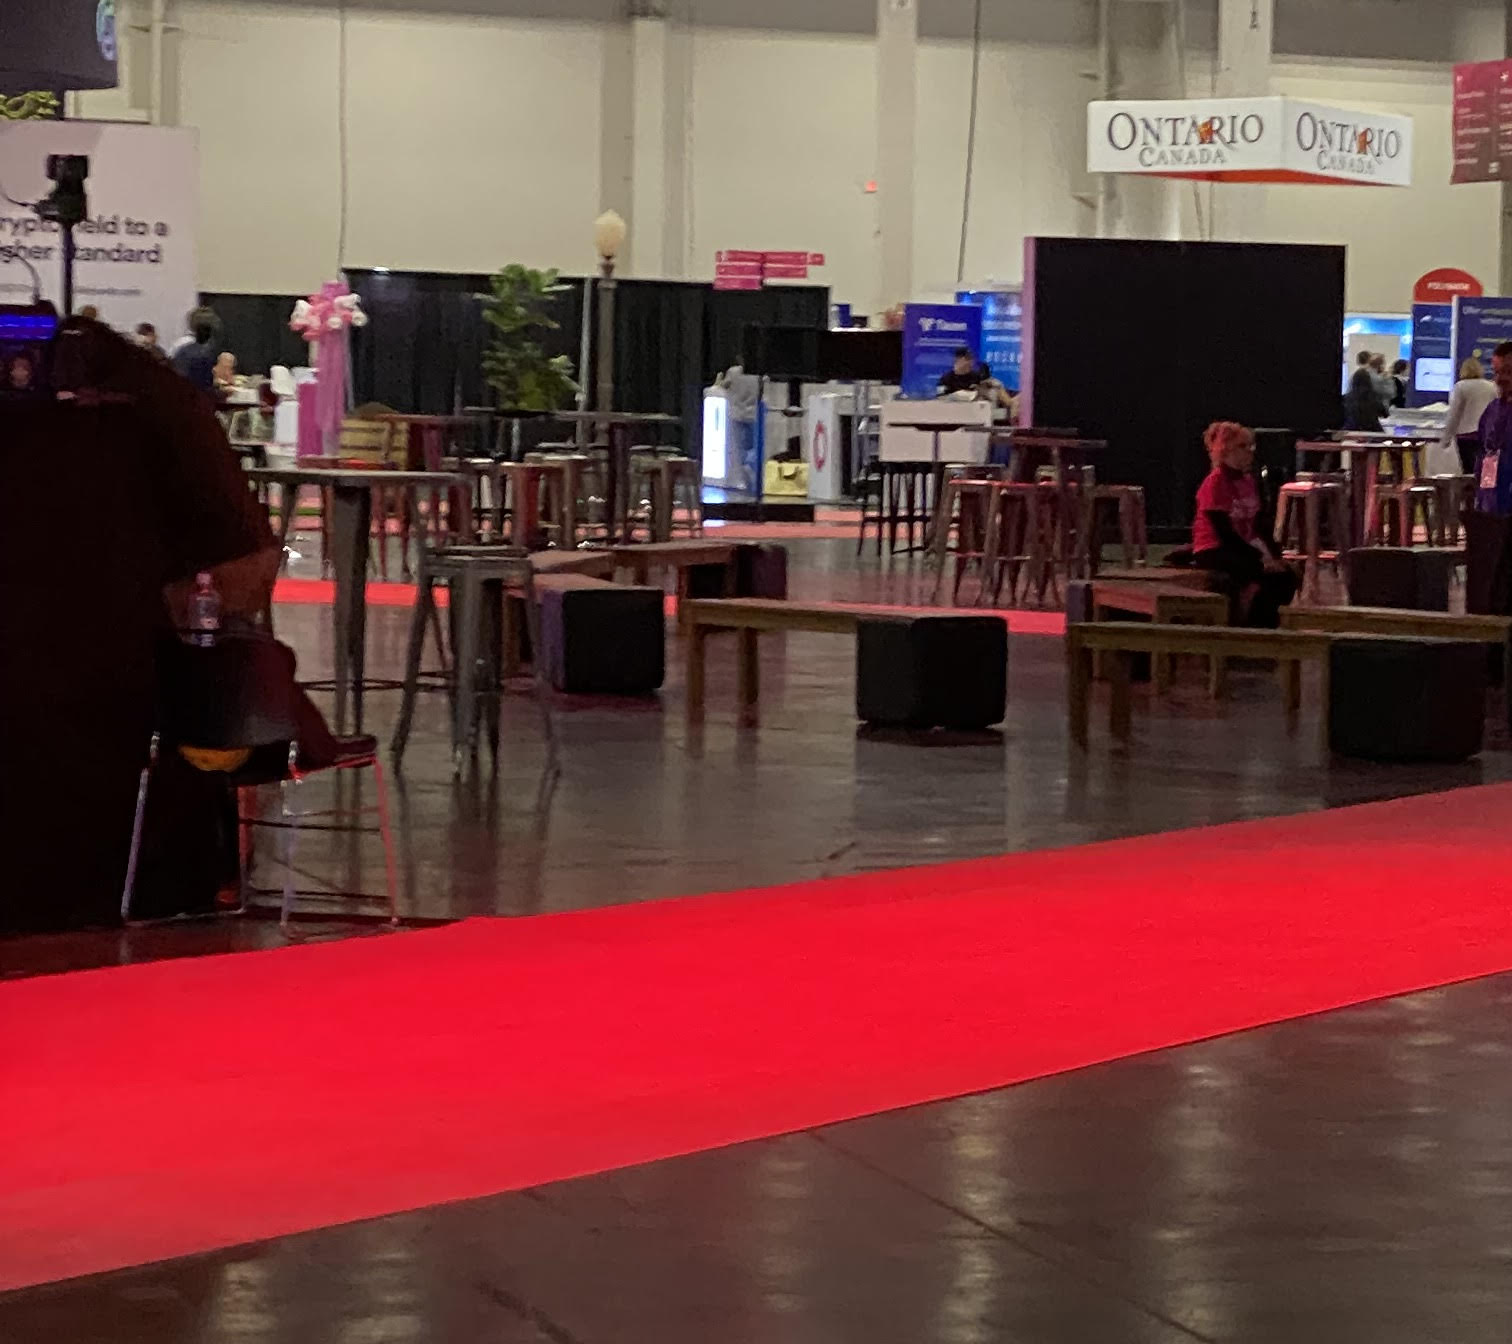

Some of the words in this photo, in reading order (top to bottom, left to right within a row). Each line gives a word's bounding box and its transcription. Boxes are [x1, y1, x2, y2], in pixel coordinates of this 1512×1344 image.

[1107, 111, 1265, 153] ONTARIO
[1297, 111, 1400, 163] ONTARIO
[1138, 147, 1226, 168] CANADA
[1316, 150, 1376, 176] CANADA
[78, 213, 119, 235] eld
